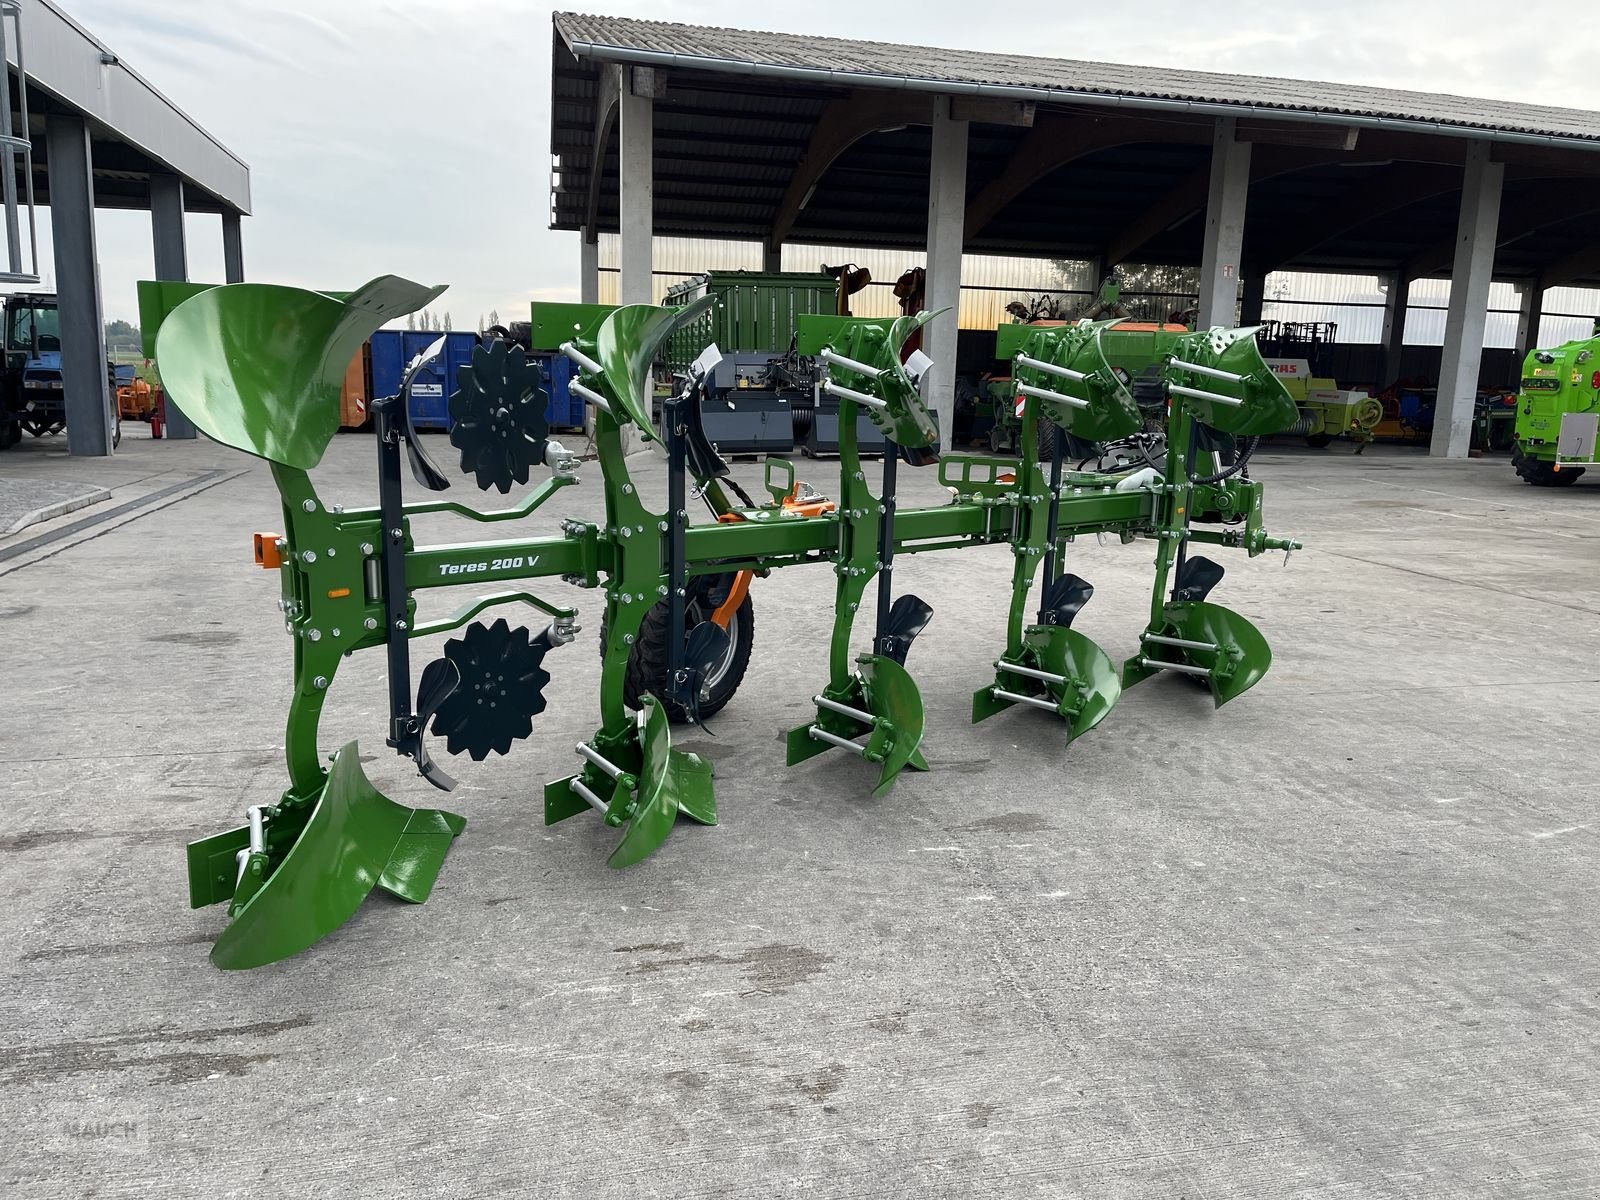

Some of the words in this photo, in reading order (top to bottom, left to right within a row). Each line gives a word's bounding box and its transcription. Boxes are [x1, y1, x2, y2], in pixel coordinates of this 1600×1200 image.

[439, 562, 487, 575] Teres
[490, 557, 523, 570] 200
[527, 555, 540, 567] V
